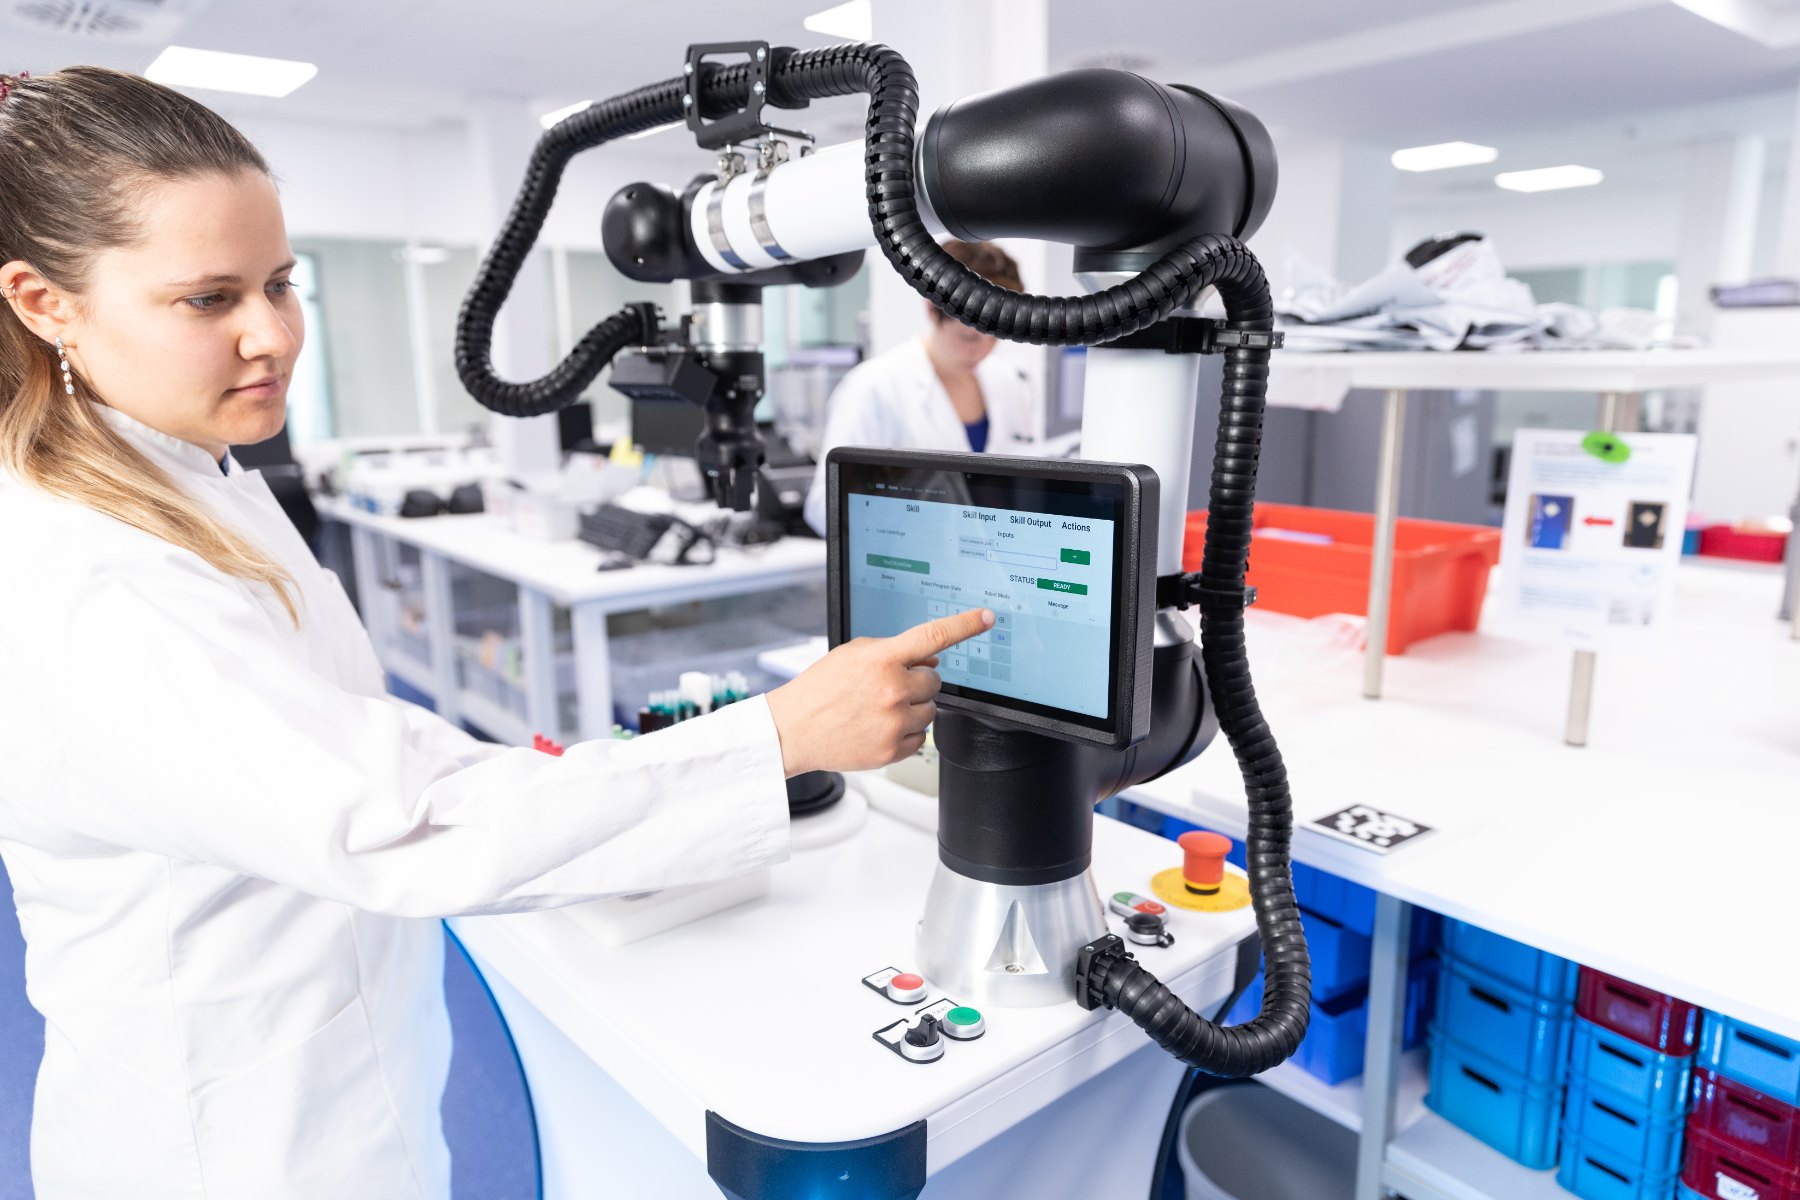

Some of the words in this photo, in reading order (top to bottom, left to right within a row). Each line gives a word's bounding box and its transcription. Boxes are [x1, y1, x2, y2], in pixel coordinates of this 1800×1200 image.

[906, 504, 920, 513] Skill
[963, 510, 977, 519] Skill
[978, 512, 997, 522] Input
[1010, 515, 1026, 525] Skill
[1027, 517, 1052, 529] Output
[1061, 521, 1091, 532] Actions
[997, 530, 1015, 539] Inputs
[1009, 574, 1037, 585] STATUS:
[1053, 582, 1071, 590] READY
